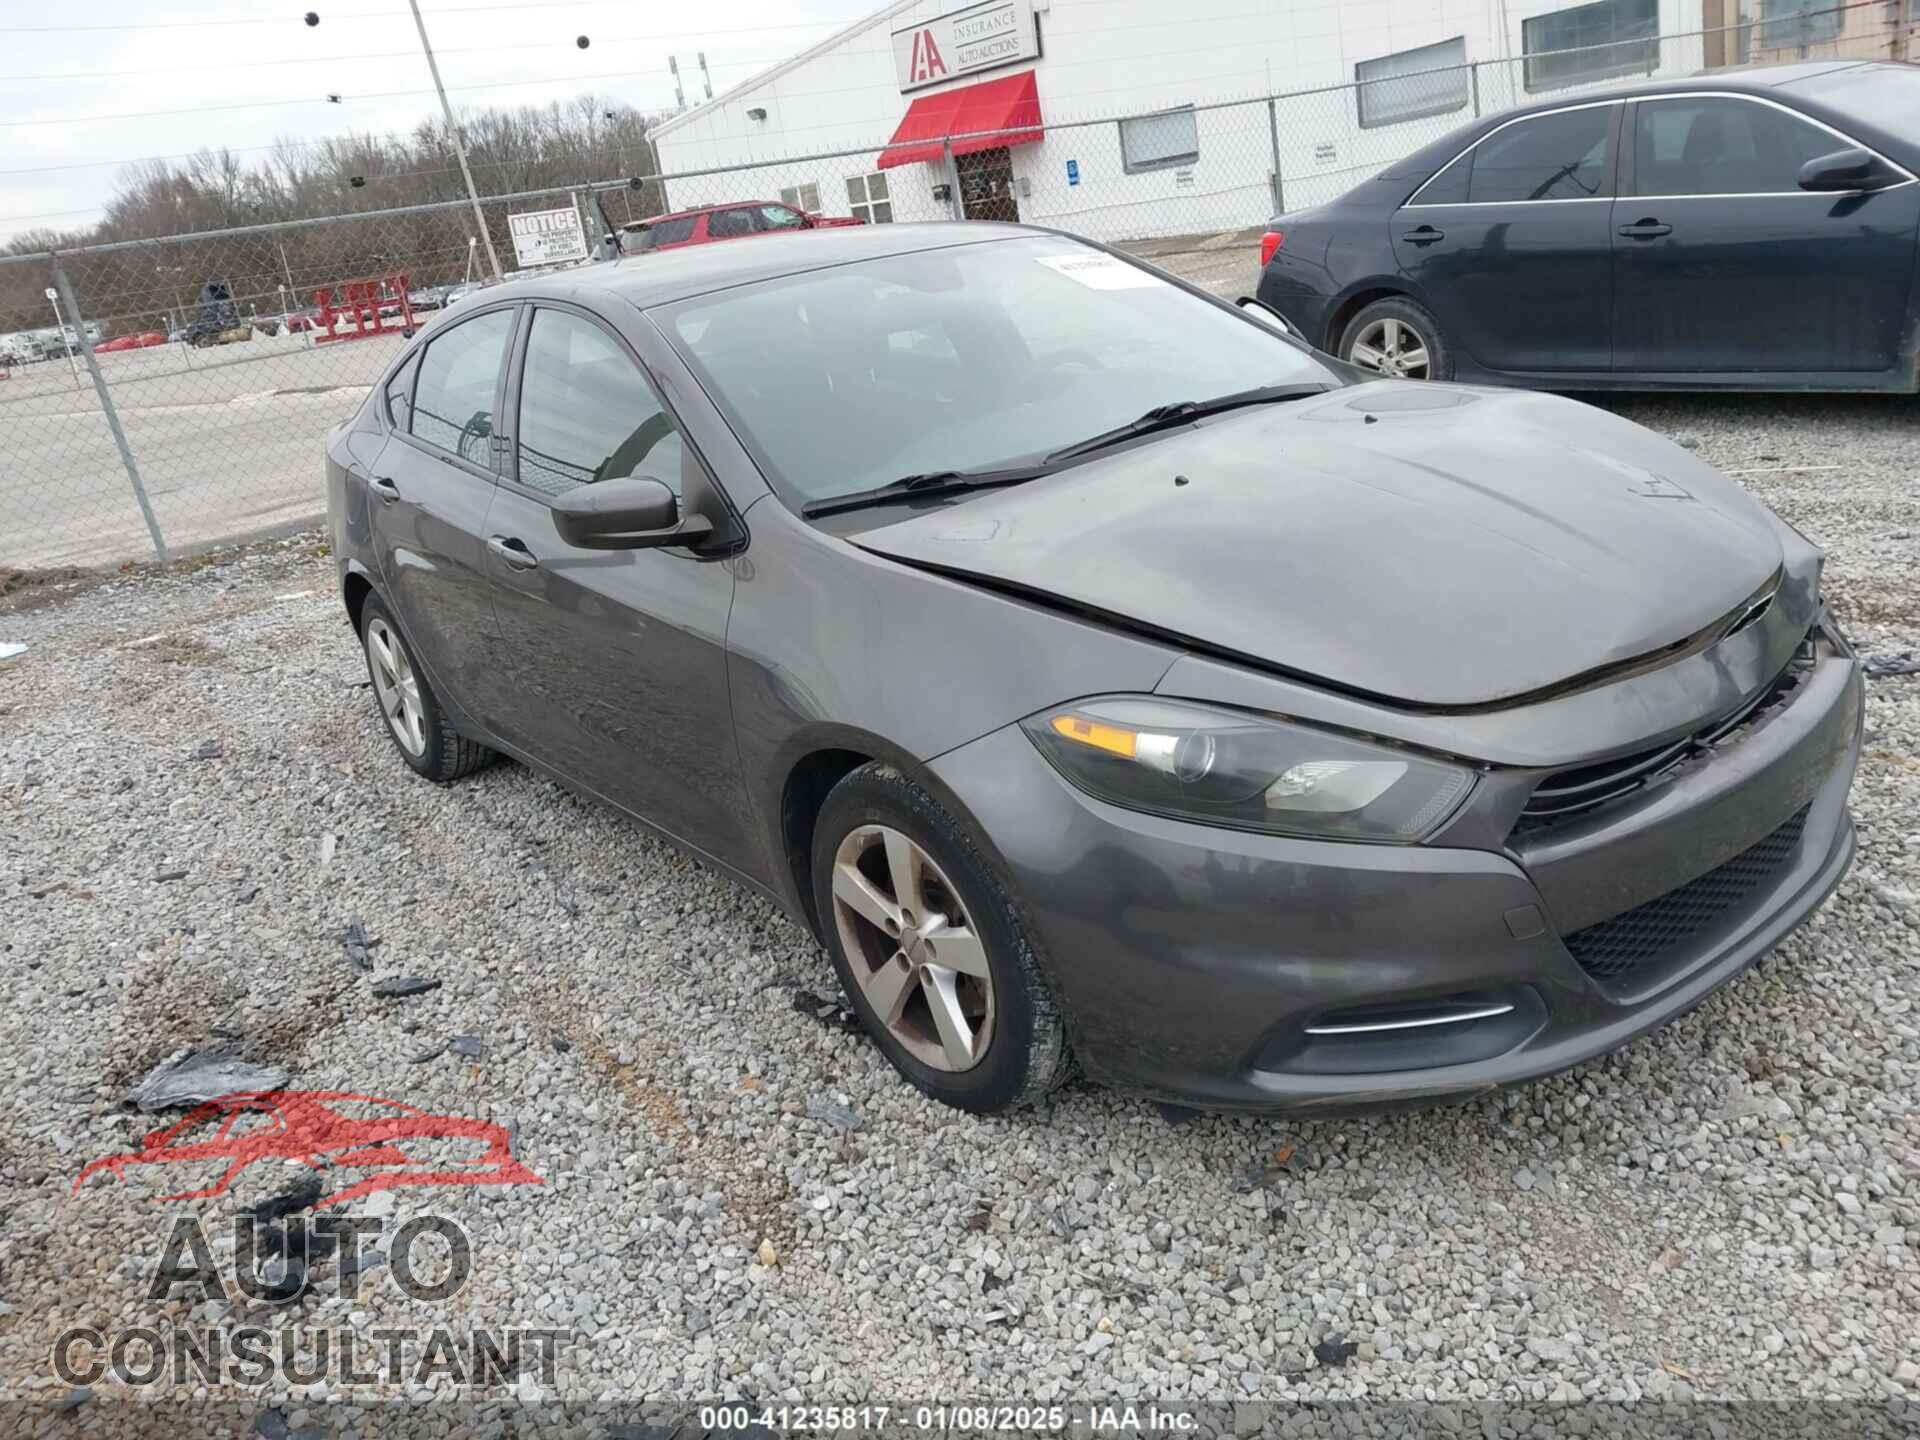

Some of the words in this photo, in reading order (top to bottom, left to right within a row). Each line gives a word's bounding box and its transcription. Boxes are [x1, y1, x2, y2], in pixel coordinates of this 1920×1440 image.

[953, 10, 1017, 41] INSURANCE
[957, 45, 980, 65] AUTO
[979, 37, 1020, 60] AUCTIONS
[512, 211, 577, 236] NOTICE
